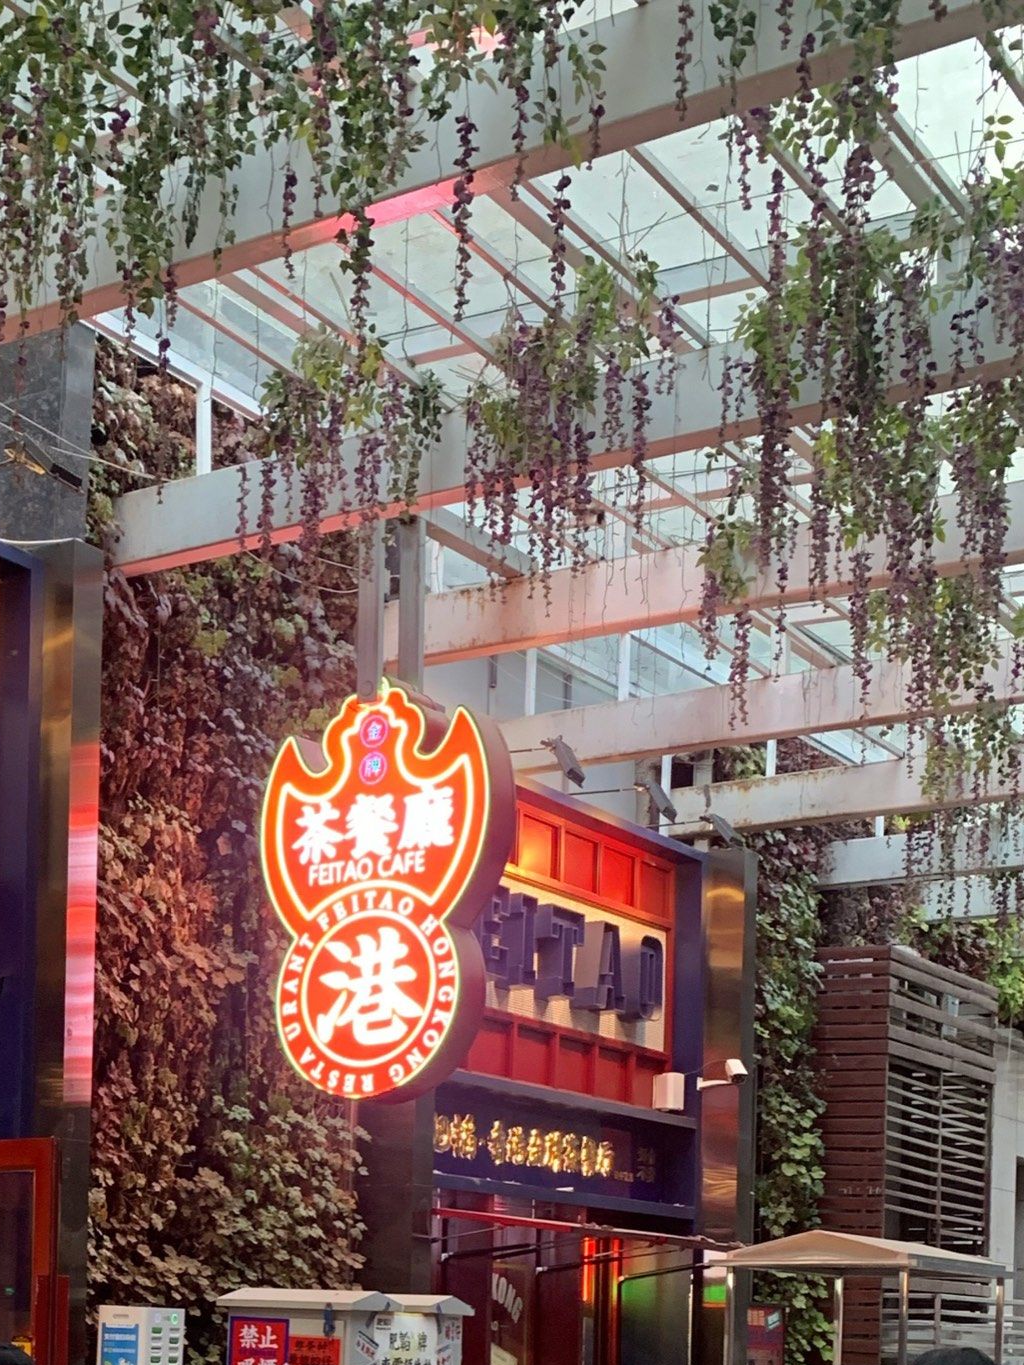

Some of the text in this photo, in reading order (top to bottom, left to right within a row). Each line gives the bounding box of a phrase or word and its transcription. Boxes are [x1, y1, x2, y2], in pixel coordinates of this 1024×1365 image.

[308, 857, 374, 887] FEITAO
[318, 889, 416, 931] FEITAO
[317, 926, 424, 1046] 港
[281, 932, 375, 1094] RESTAURANT
[239, 1324, 279, 1349] 禁止
